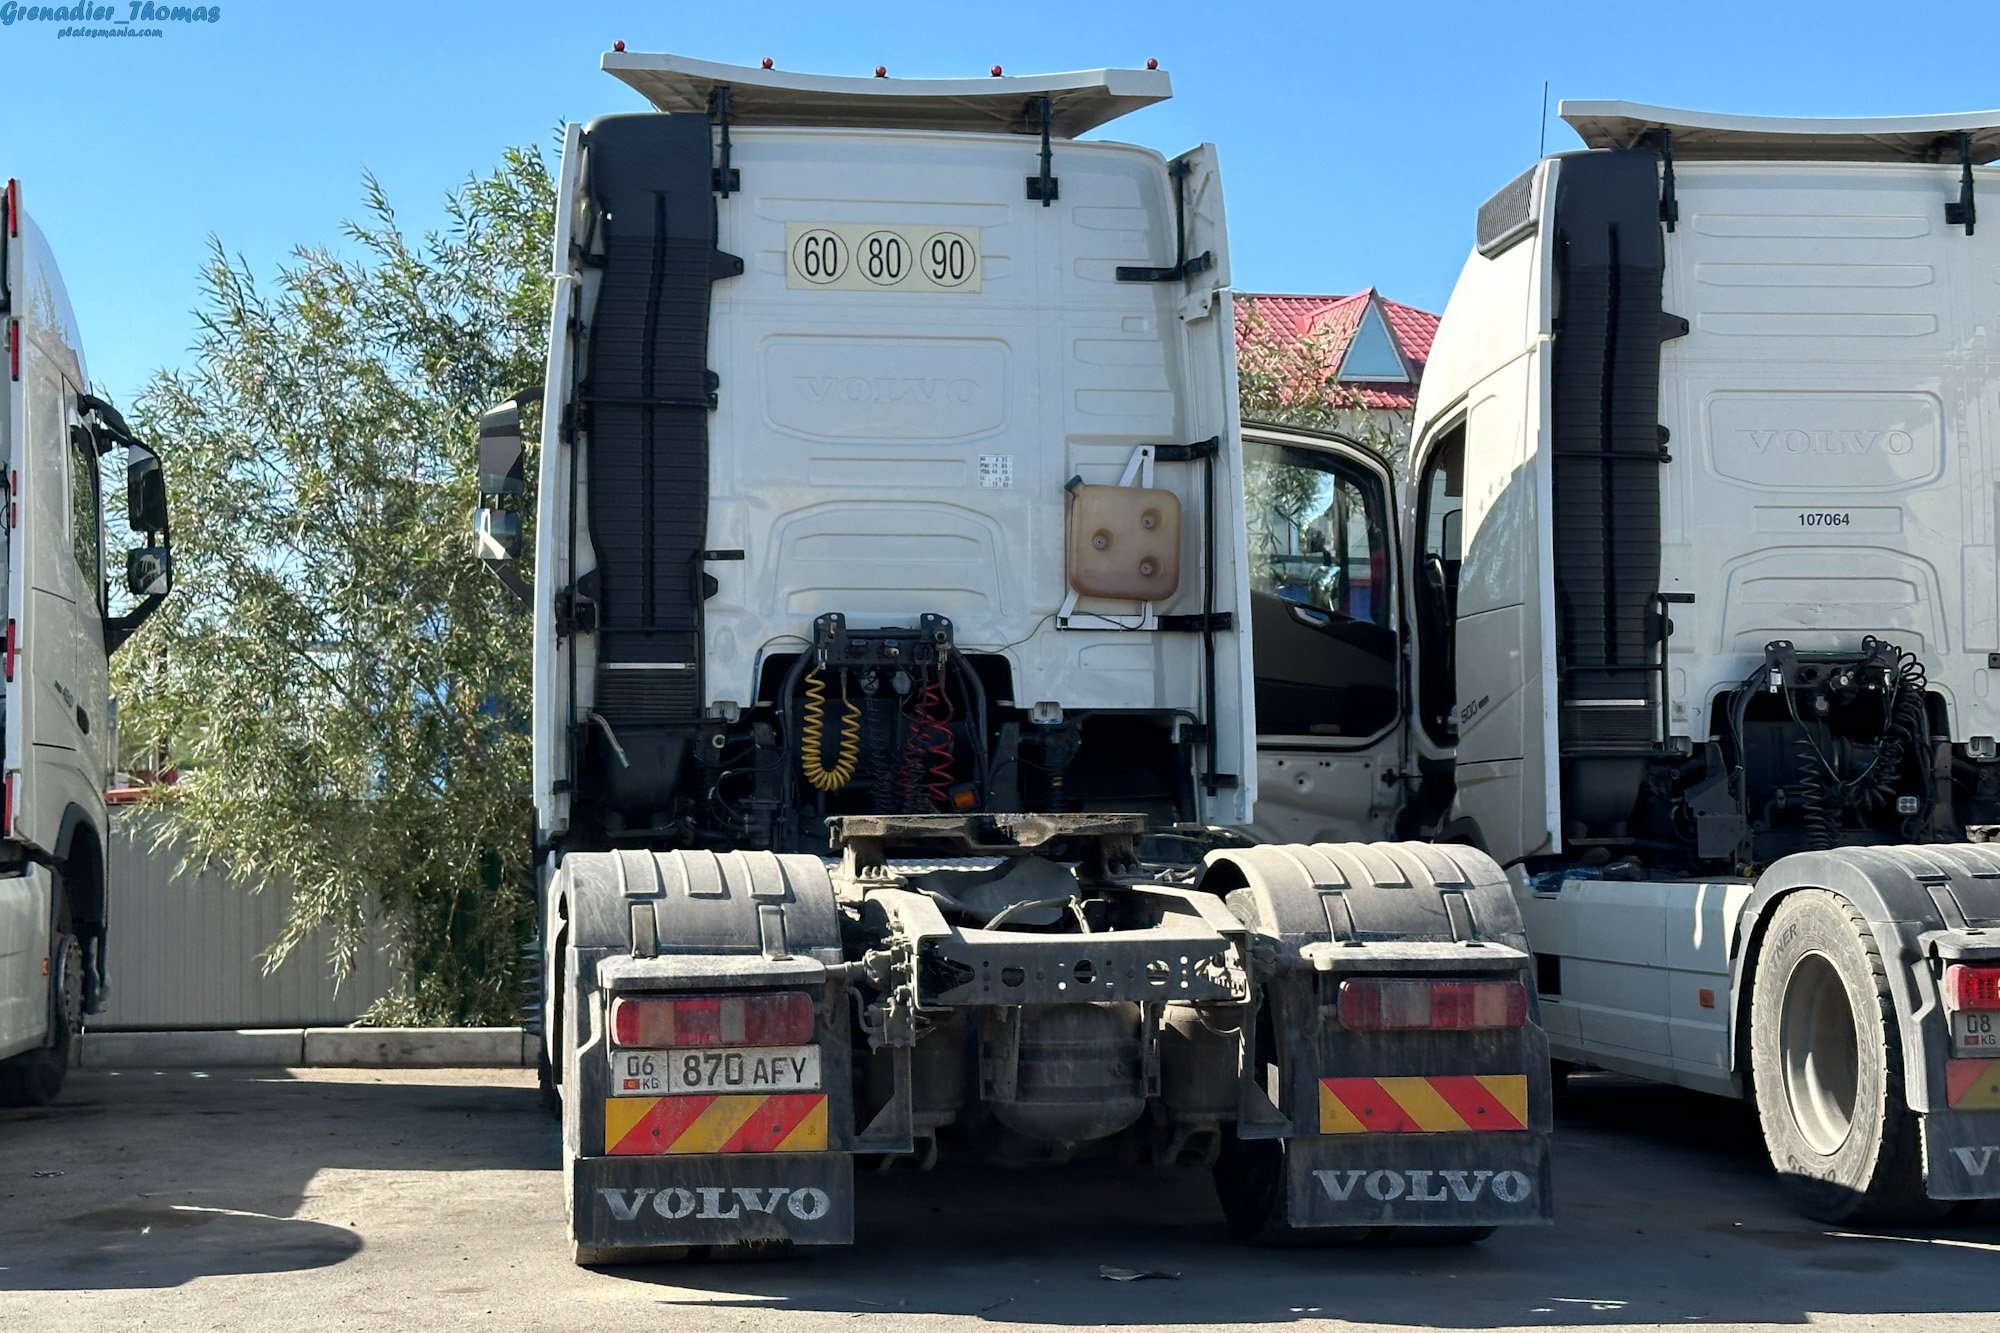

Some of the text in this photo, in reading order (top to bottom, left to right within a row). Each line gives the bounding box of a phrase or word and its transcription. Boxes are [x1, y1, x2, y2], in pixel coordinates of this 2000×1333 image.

[804, 236, 965, 280] 60 80 90
[791, 376, 981, 404] VOLVO
[1733, 429, 1914, 456] VOLVO
[1798, 513, 1850, 526] 107064
[1966, 1014, 1991, 1033] 08
[1981, 1034, 1996, 1046] KG
[627, 1053, 807, 1087] 06 870 AFY
[642, 1077, 659, 1089] KG
[1949, 1145, 2000, 1176] V
[1311, 1169, 1532, 1202] VOLVO
[596, 1187, 831, 1221] VOLVO
